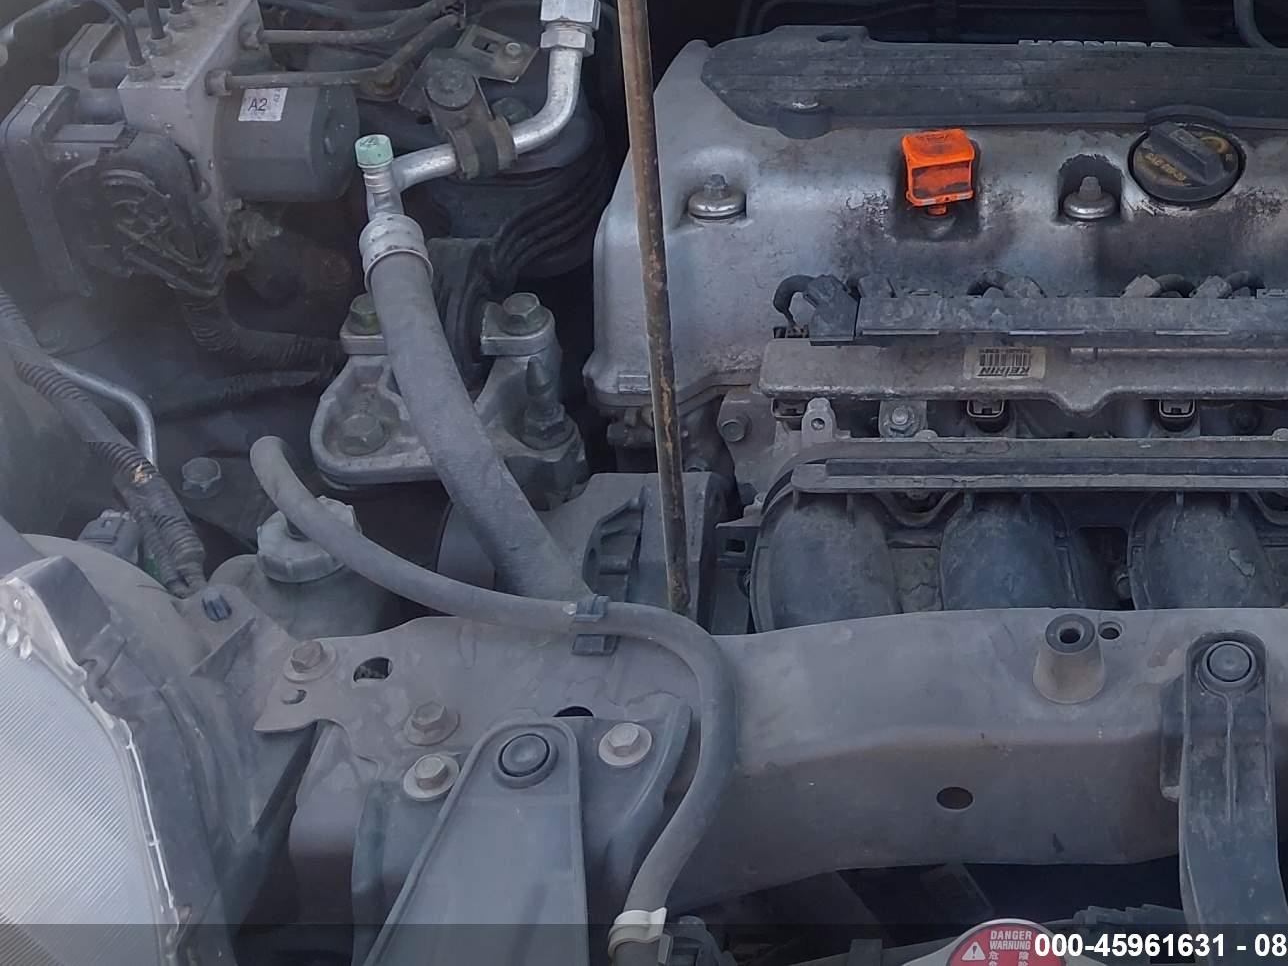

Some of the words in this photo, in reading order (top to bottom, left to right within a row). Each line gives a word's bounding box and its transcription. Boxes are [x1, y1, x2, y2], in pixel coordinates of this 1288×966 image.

[247, 97, 267, 113] A2
[978, 366, 1030, 377] KEIHIN
[990, 930, 1032, 940] DANGER
[989, 940, 1031, 951] WARNUNG
